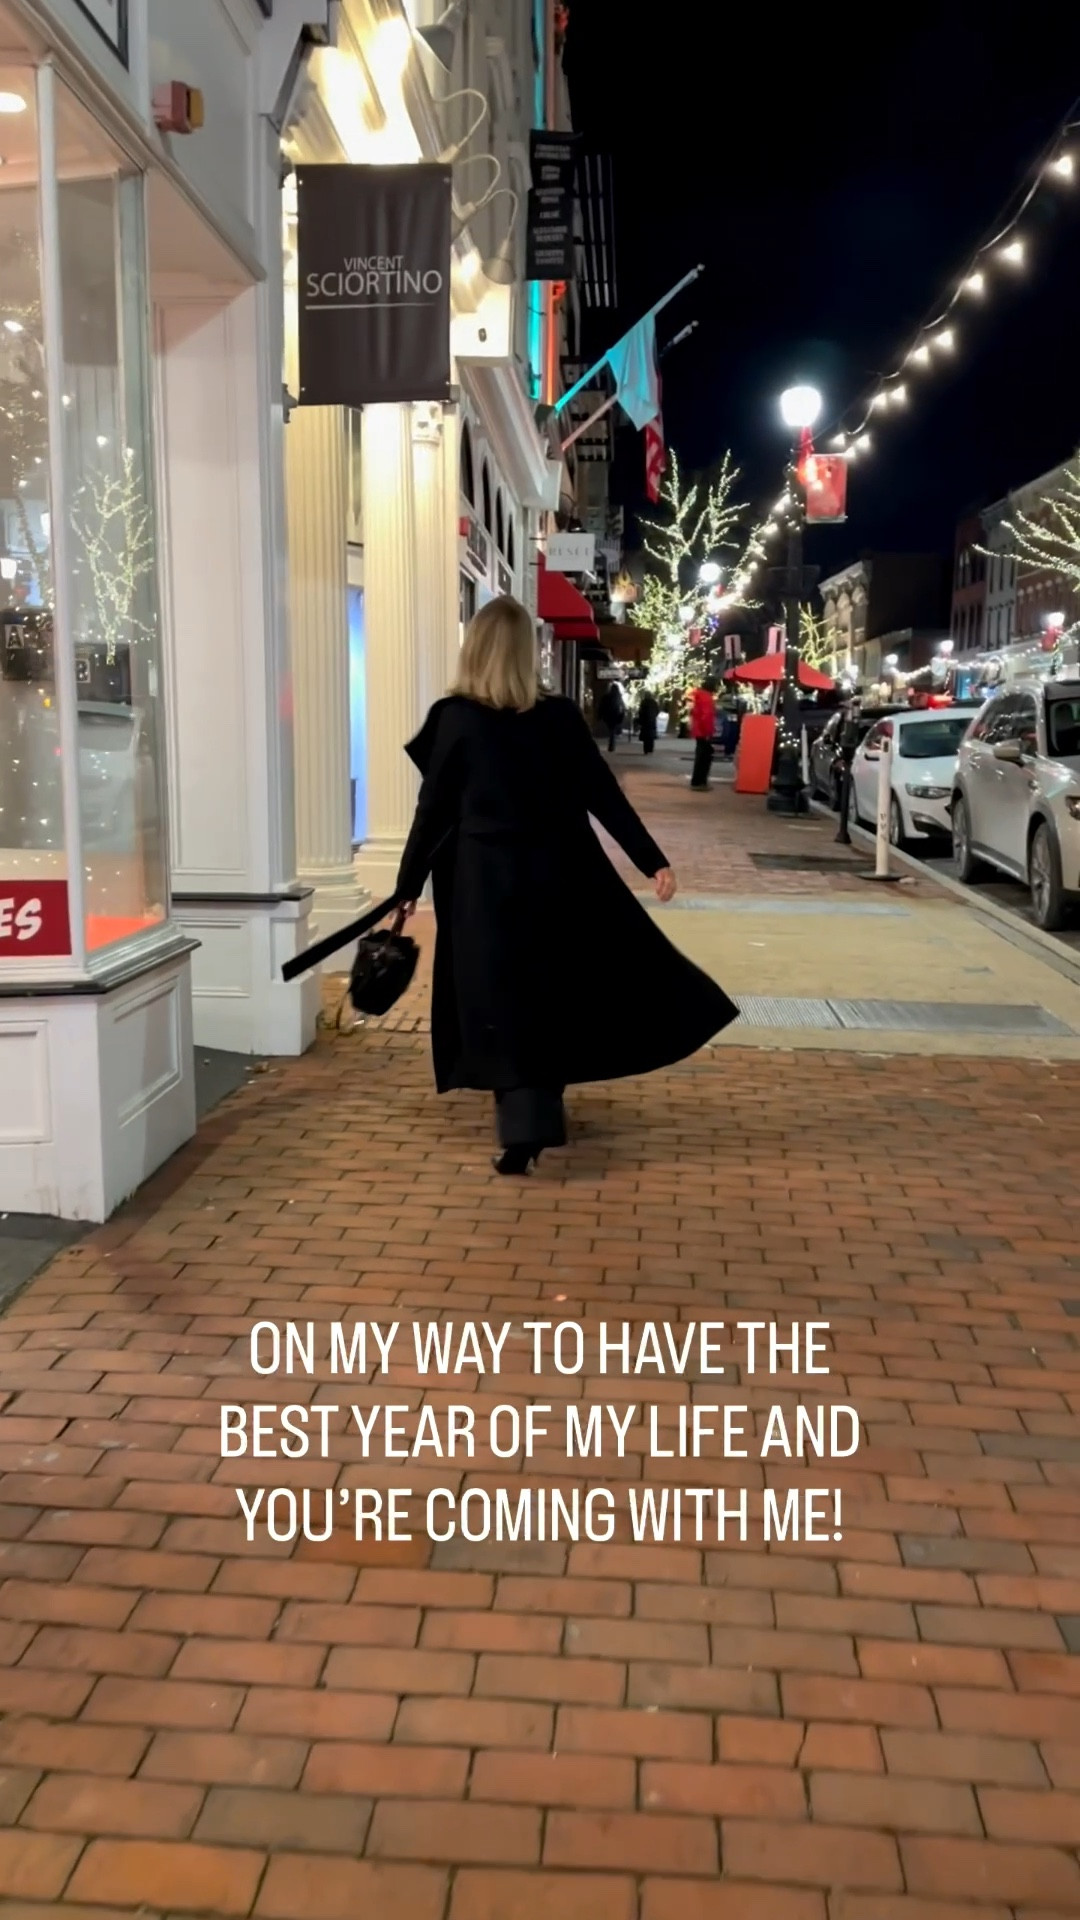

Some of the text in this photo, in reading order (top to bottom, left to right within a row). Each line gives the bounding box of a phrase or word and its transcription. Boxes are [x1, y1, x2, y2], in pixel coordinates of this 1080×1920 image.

[343, 255, 404, 271] VINCENT
[306, 270, 443, 297] SCIORTINO
[0, 897, 43, 941] ES
